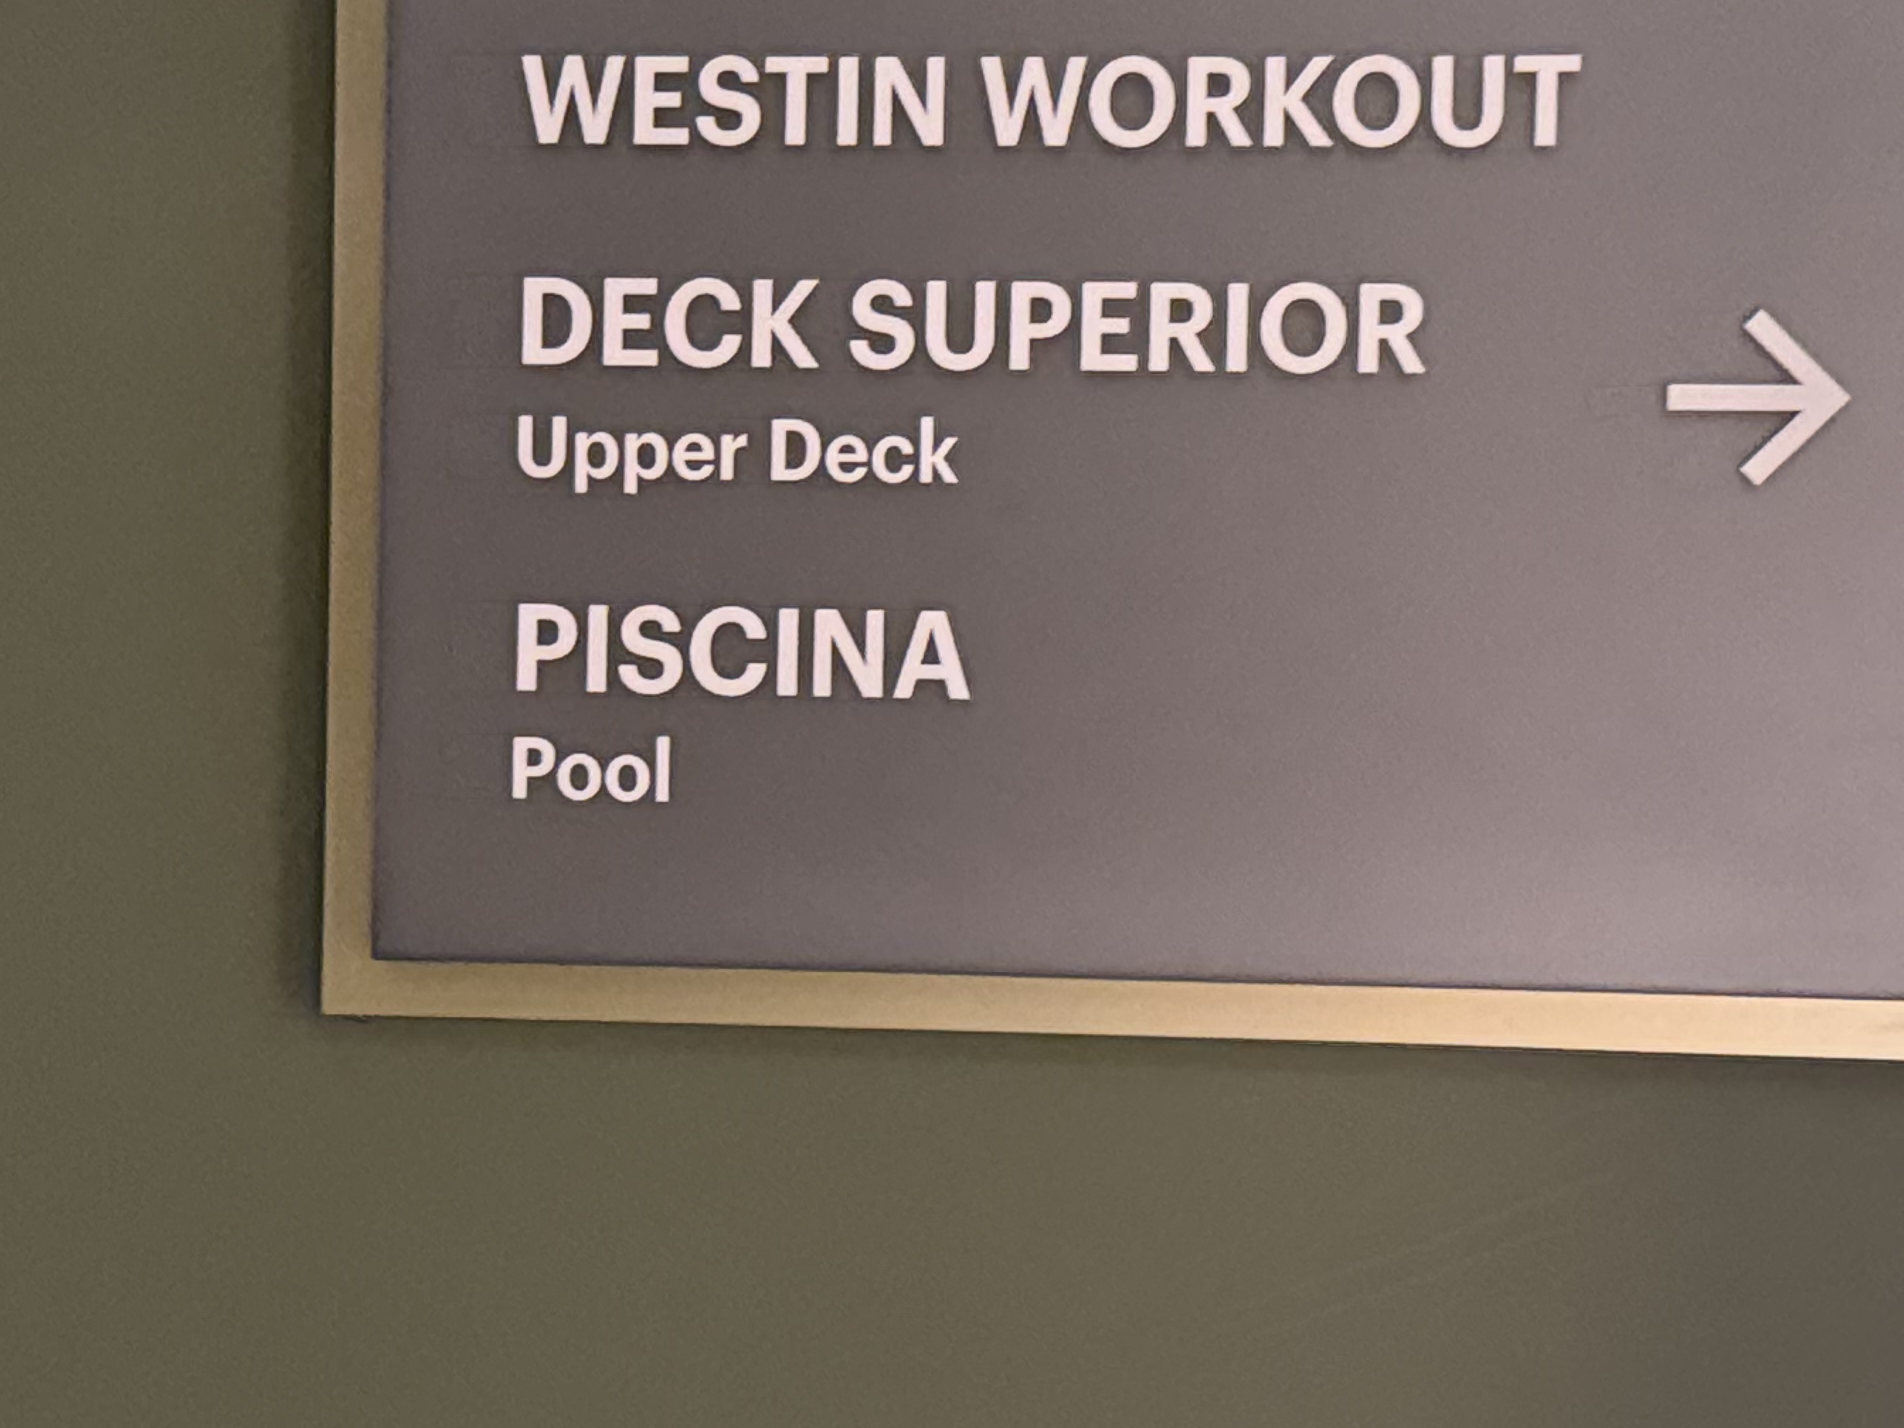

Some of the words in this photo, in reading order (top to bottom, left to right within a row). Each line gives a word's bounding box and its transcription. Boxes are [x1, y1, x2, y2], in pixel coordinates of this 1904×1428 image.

[520, 53, 947, 148] WESTIN
[980, 52, 1584, 149] WORKOUT
[520, 275, 820, 370] DECK
[848, 277, 1429, 376] SUPERIOR
[517, 413, 748, 497] Upper
[769, 416, 960, 486] Deck
[515, 602, 971, 701] PISCINA
[510, 734, 673, 804] Pool
